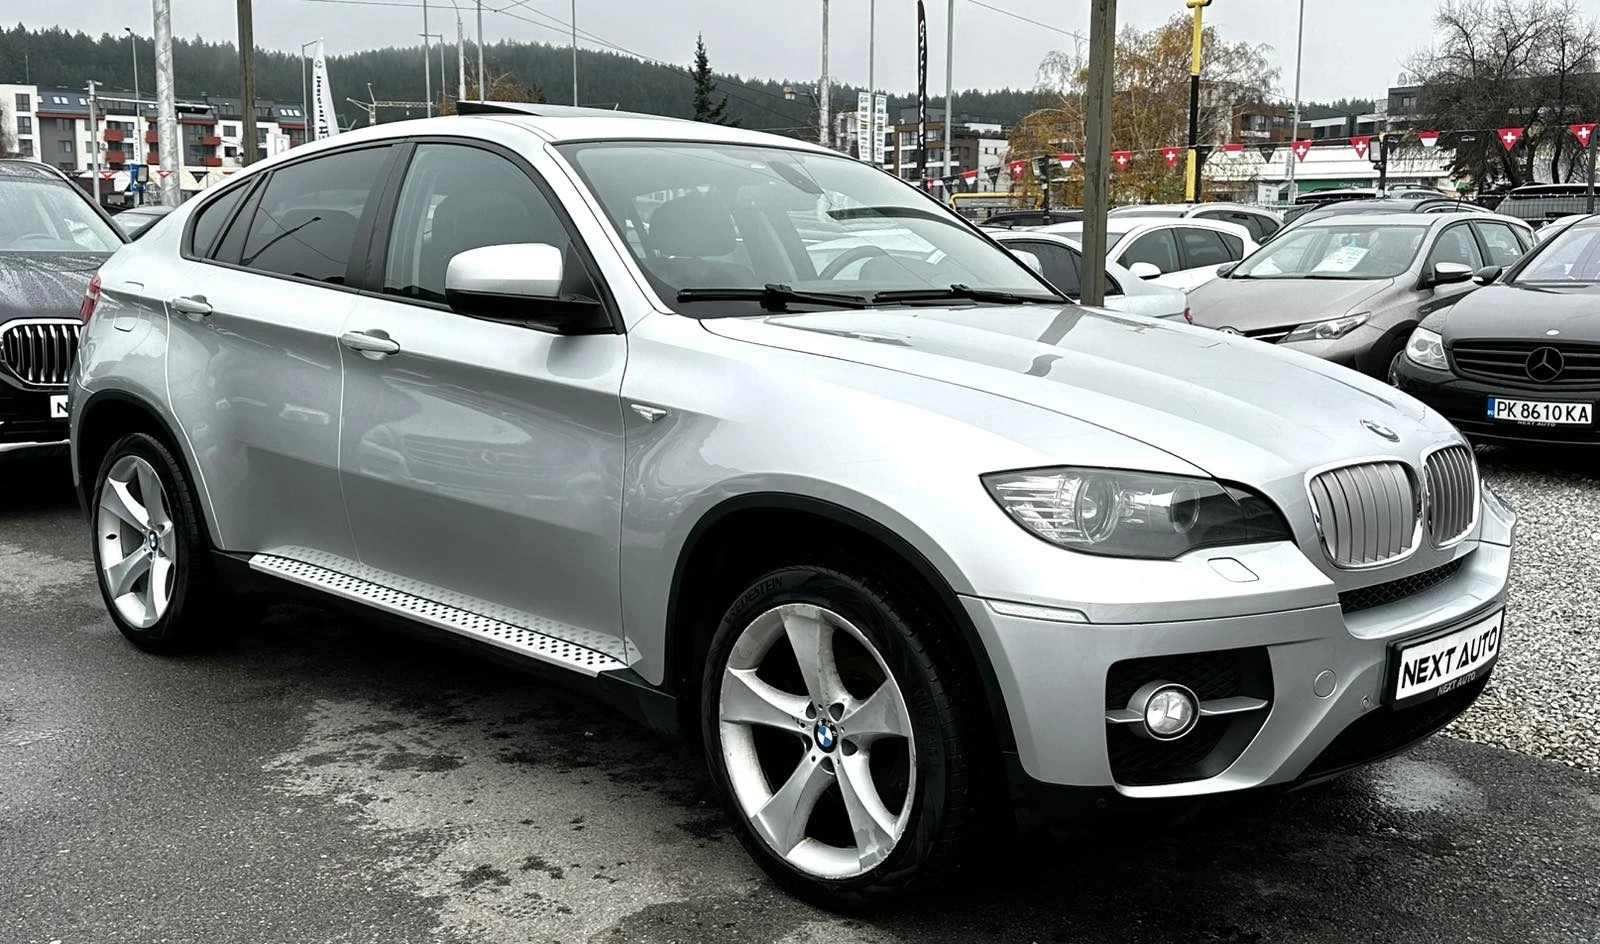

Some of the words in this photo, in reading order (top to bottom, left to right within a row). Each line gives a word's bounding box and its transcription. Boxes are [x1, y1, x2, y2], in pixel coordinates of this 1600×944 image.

[1520, 403, 1562, 421] 8610
[1401, 646, 1457, 689] NEXT
[1456, 625, 1498, 670] AUTO
[1436, 679, 1458, 697] NEXT
[1456, 670, 1476, 688] AUTO
